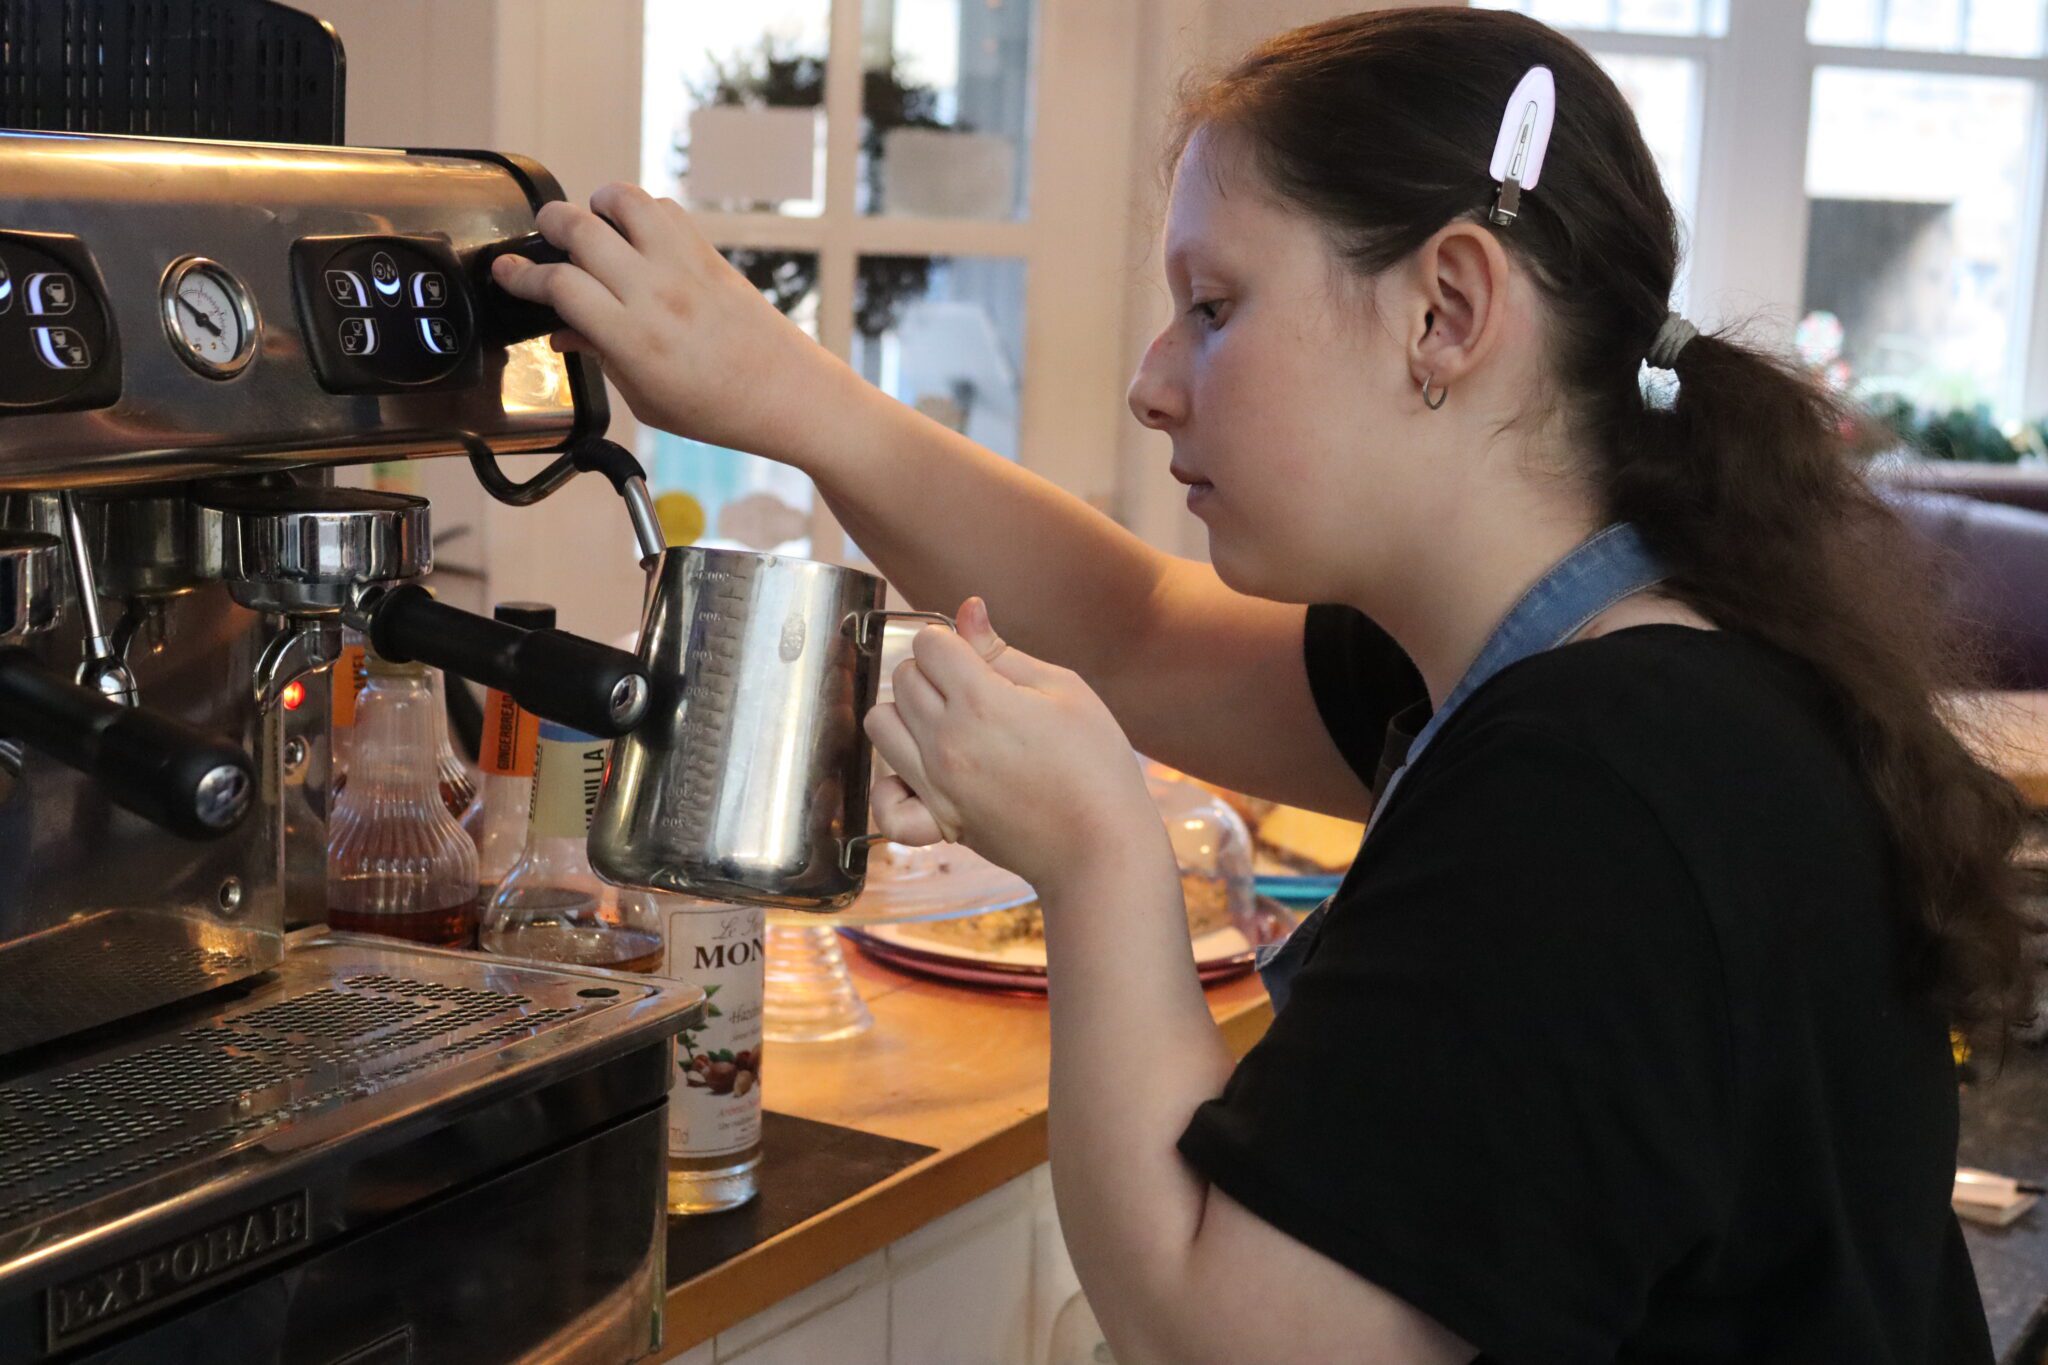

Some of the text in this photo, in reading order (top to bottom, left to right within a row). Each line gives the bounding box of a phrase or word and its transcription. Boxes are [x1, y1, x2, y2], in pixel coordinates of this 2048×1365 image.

[497, 694, 515, 770] GINGERBREAD
[583, 748, 605, 830] ANILLA
[59, 1205, 299, 1332] EXPOBAR
